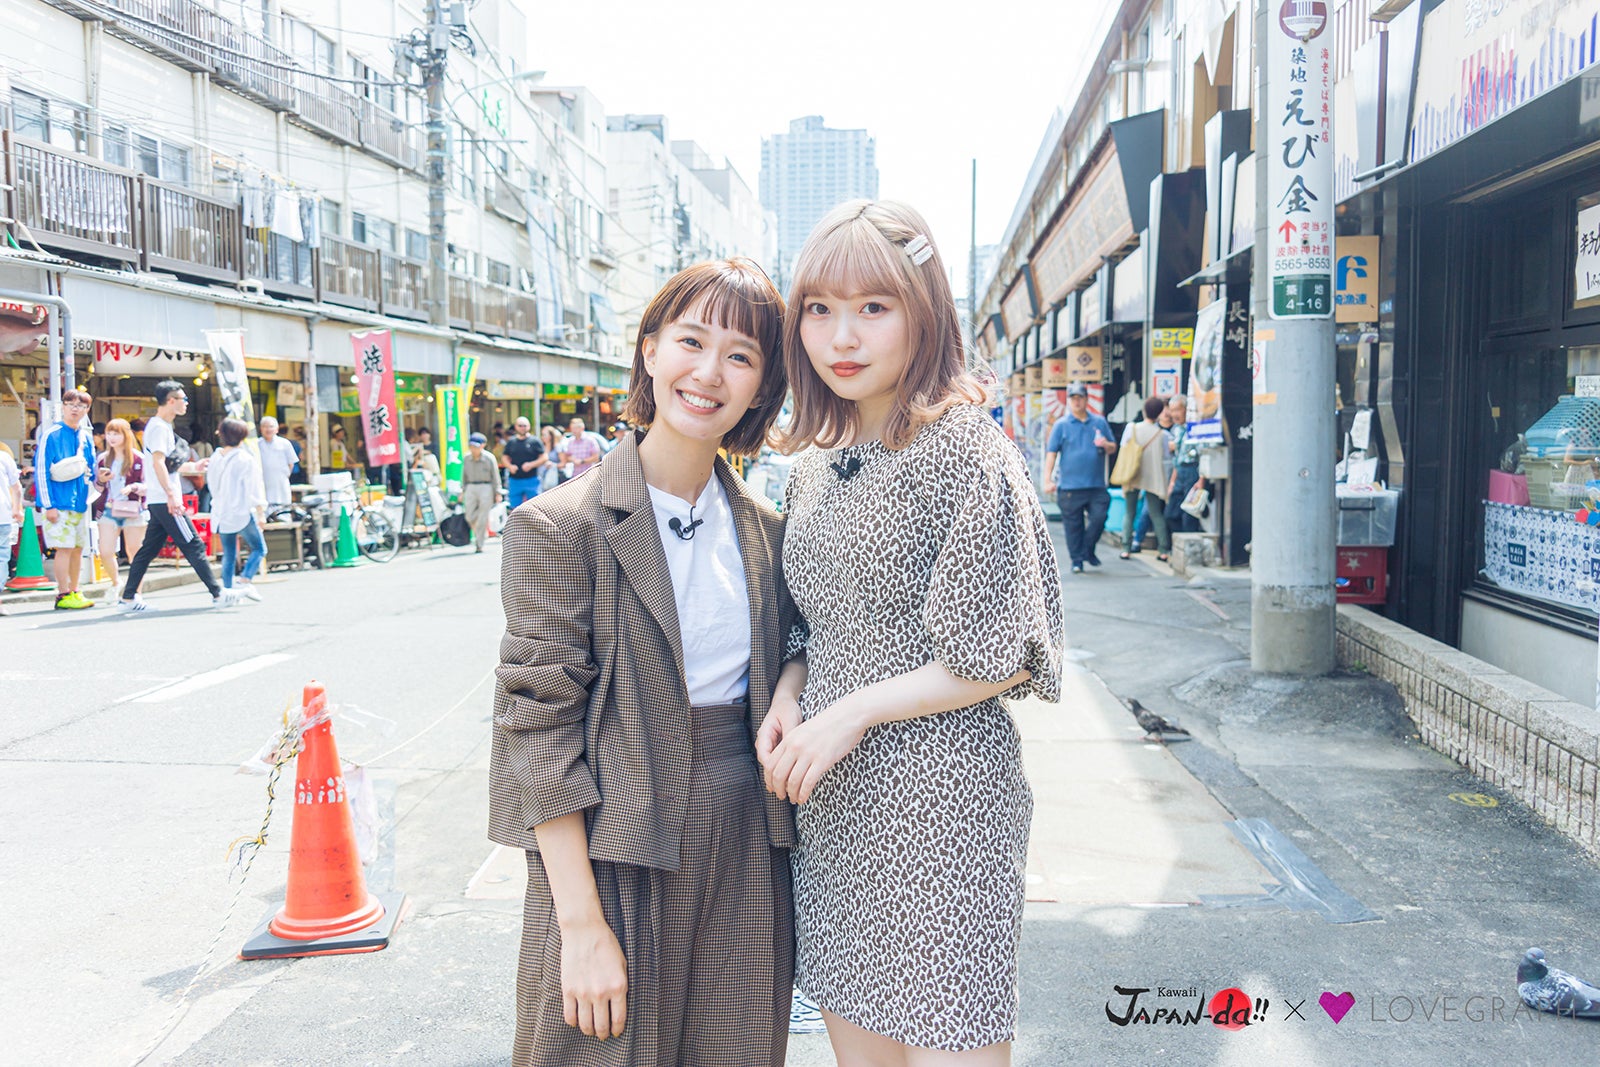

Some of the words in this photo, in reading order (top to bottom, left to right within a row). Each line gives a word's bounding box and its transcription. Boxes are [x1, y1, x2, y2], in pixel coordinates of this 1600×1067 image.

[1274, 258, 1330, 271] 5565-8553
[1286, 298, 1322, 310] 4-16
[1226, 300, 1248, 349] 長崎
[1163, 330, 1191, 339] コイン
[1153, 340, 1190, 348] ロッカー
